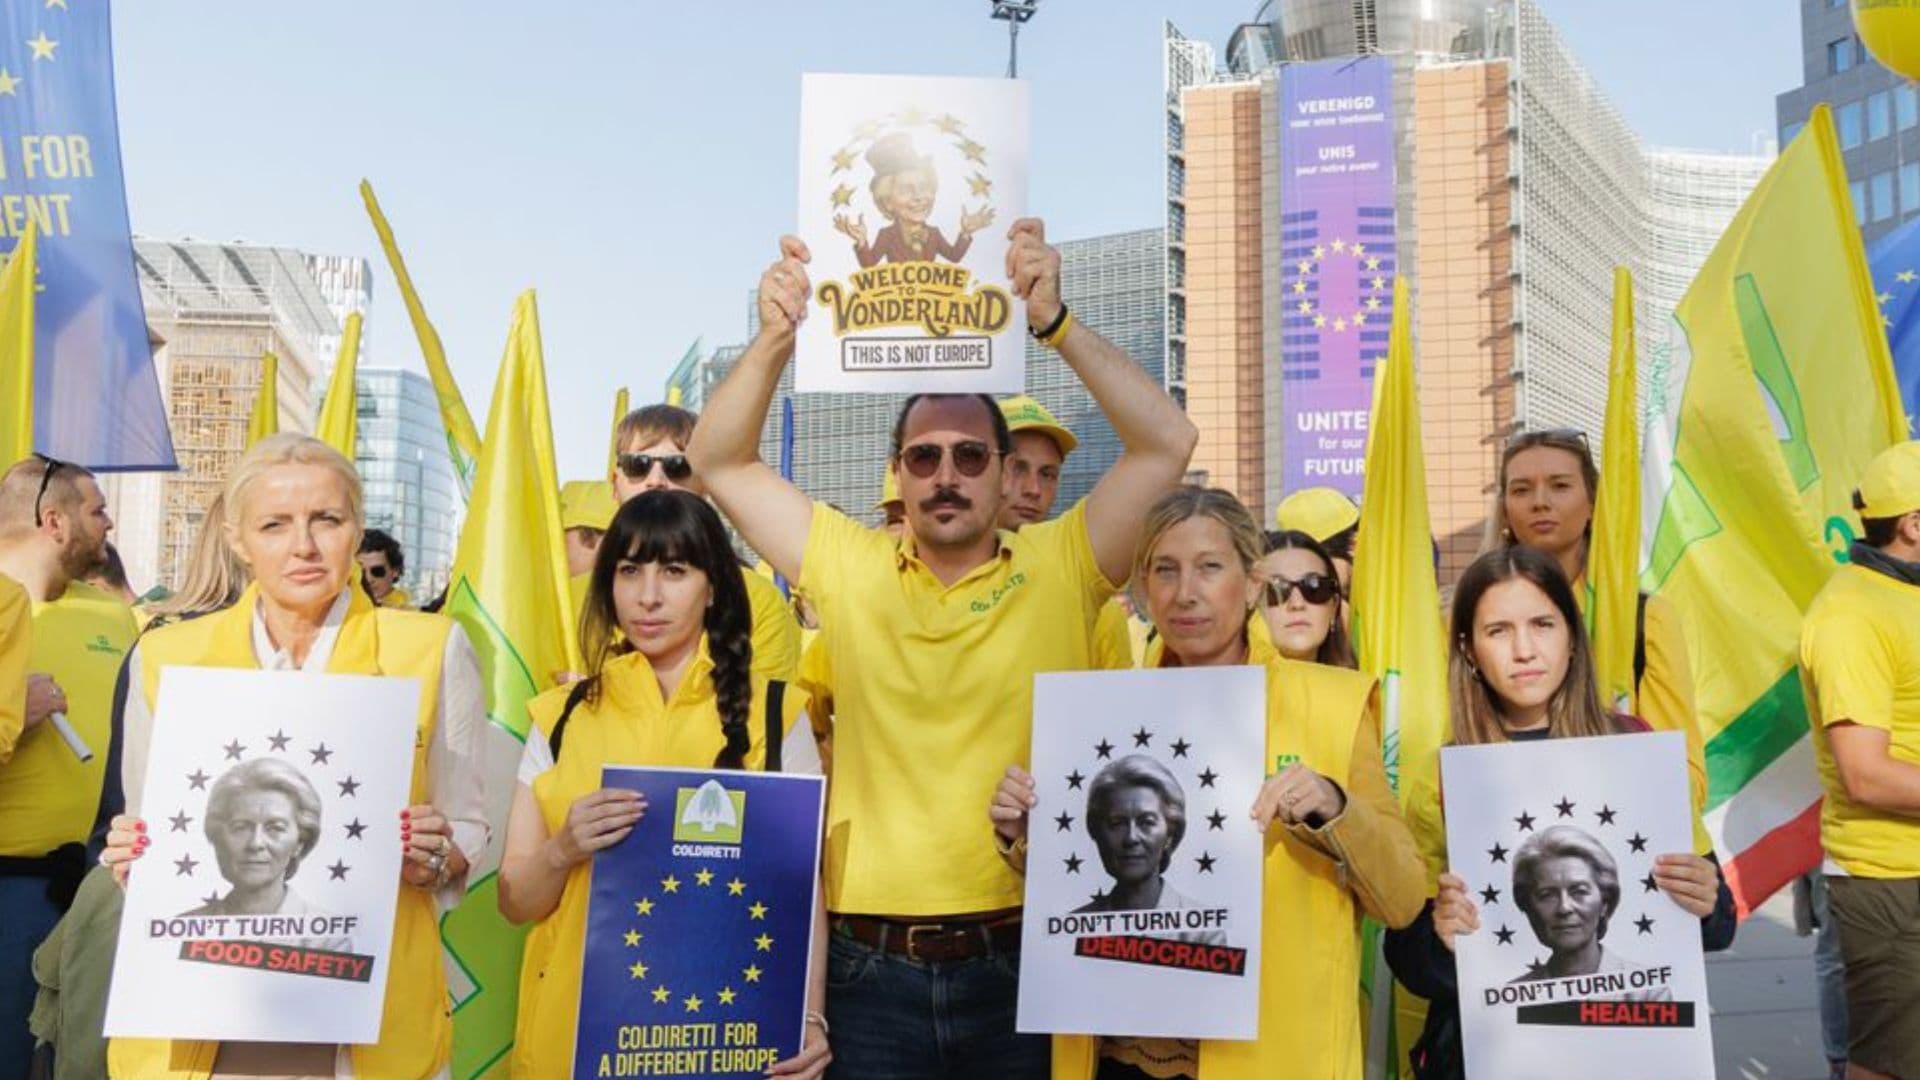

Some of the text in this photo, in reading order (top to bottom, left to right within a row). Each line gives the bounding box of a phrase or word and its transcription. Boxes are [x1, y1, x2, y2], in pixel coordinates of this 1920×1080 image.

[1298, 96, 1375, 114] VERENIGD
[21, 134, 94, 179] FOR
[1319, 145, 1355, 160] UNIS
[854, 265, 965, 291] WELCOME
[898, 285, 916, 297] TO
[819, 284, 1009, 336] VONDERLAND
[851, 343, 985, 365] THIS IS NOT EUROPE
[1297, 410, 1368, 432] UNITE
[1319, 437, 1364, 449] for our
[1304, 458, 1366, 476] FUTUR
[672, 844, 740, 859] COLDIRETTI
[149, 916, 357, 938] DON'T TURN OFF
[1049, 909, 1228, 935] DON'T TURN OFF
[189, 940, 367, 978] FOOD SAFETY
[1082, 936, 1243, 972] DEMOCRACY
[1484, 966, 1672, 1006] DON'T TURN OFF
[1580, 1002, 1679, 1025] HEALTH
[618, 1022, 758, 1050] COLDIRETTI FOR
[598, 1048, 779, 1078] A DIFFERENT EUROPE
